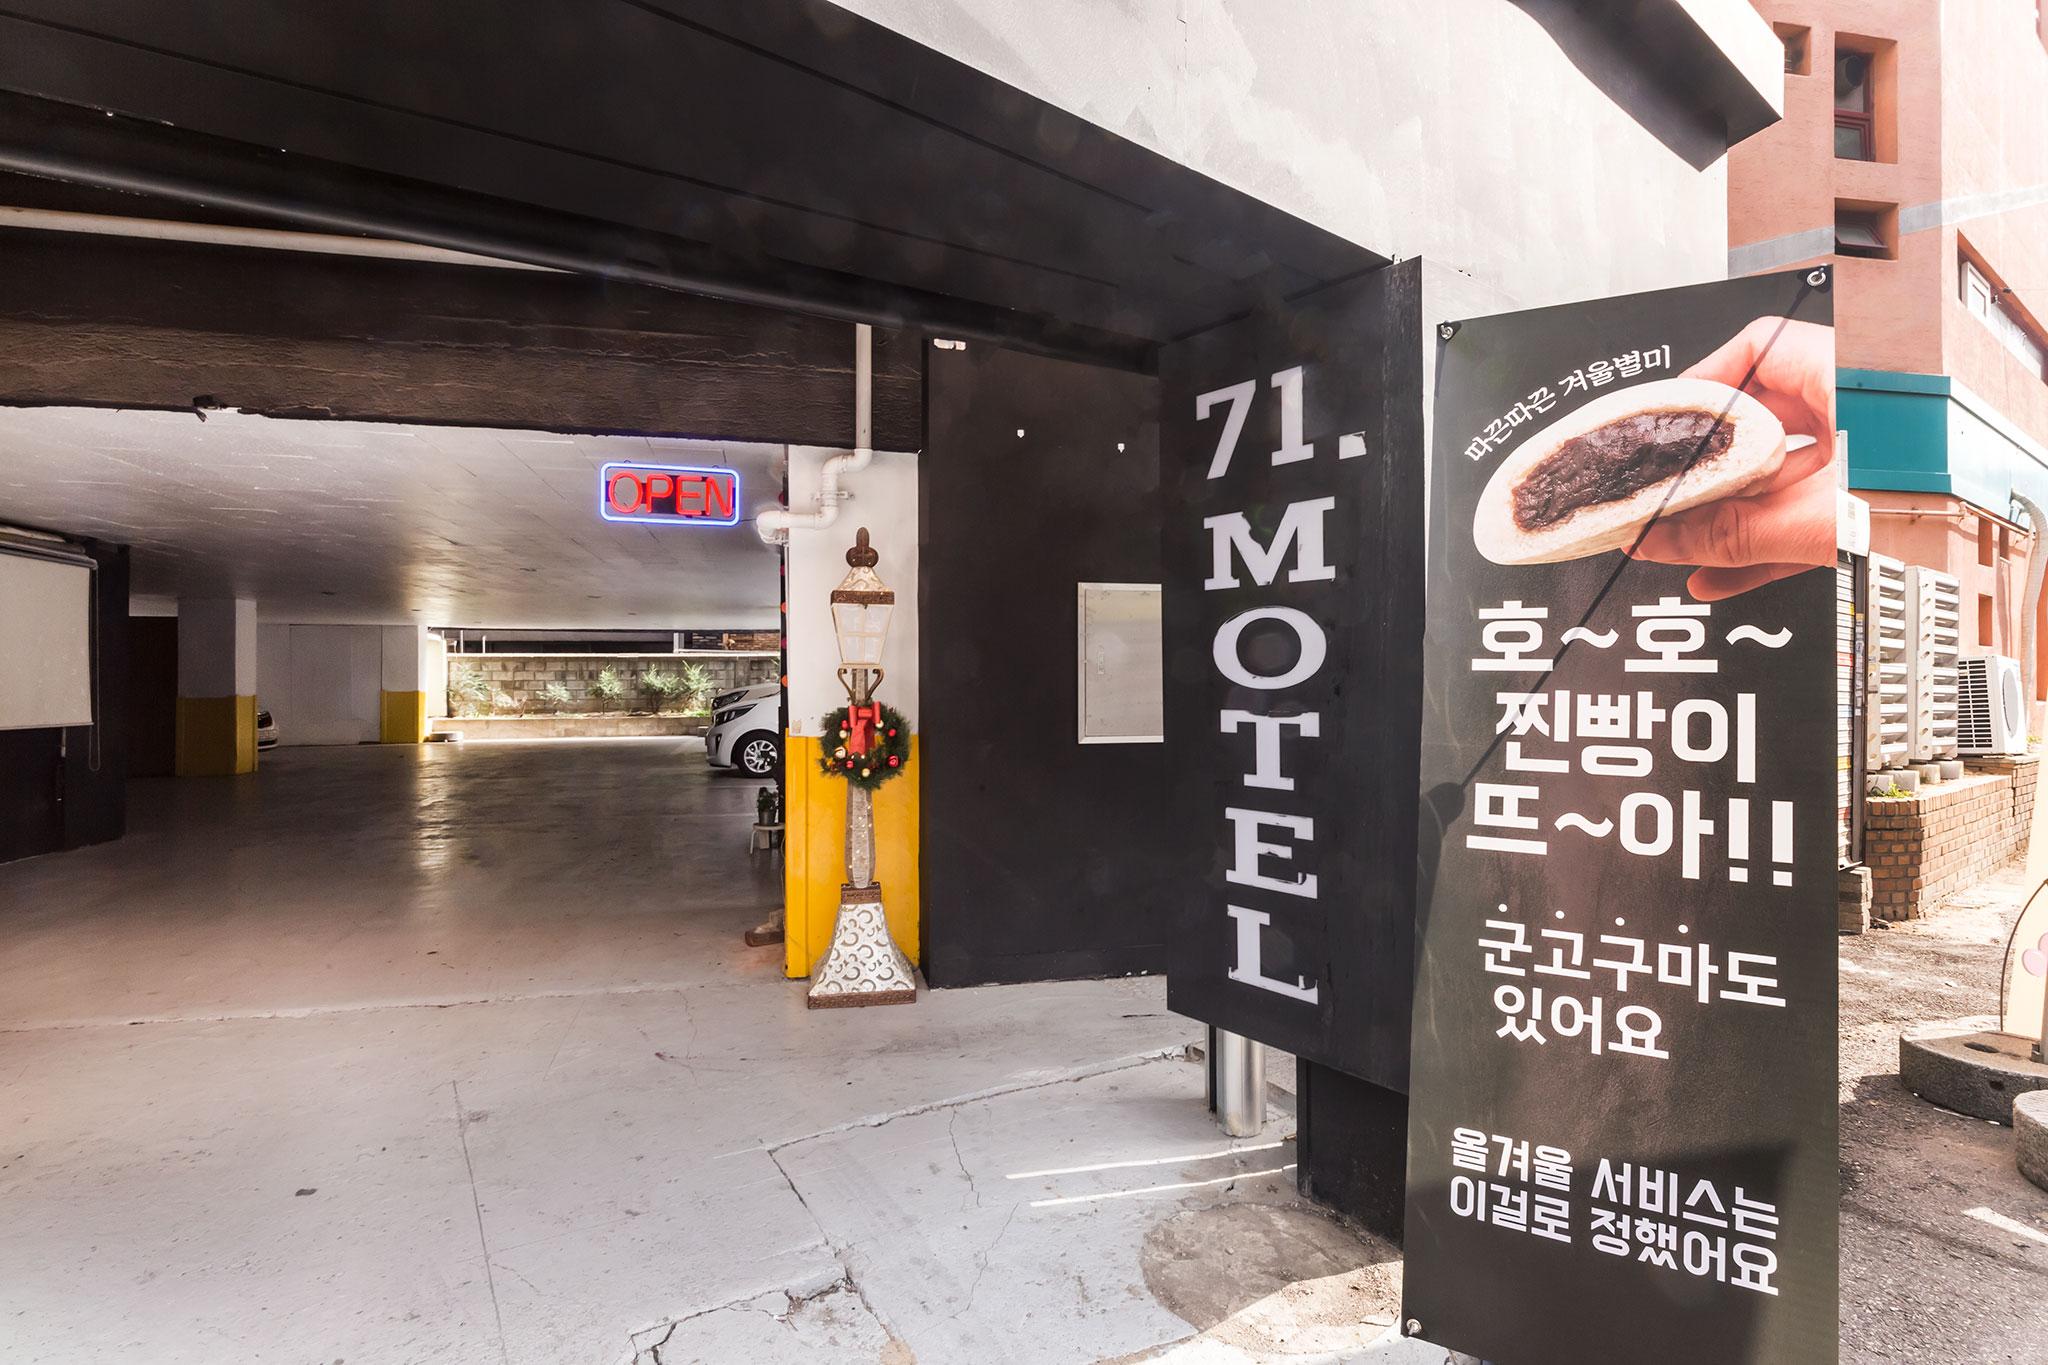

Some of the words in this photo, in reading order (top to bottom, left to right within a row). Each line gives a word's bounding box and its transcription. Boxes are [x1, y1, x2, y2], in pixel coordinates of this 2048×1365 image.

[1195, 366, 1367, 480] 71.
[1464, 386, 1557, 462] 따끈따끈
[1558, 345, 1671, 397] 겨울별미
[608, 471, 733, 518] OPEN
[1204, 496, 1336, 1006] MOTEL
[1493, 689, 1757, 785] 찐빵이
[1466, 782, 1794, 887] 뜨~아!!
[1478, 904, 1787, 1008] 군고구마도
[1493, 985, 1670, 1060] 있어요
[1450, 1127, 1574, 1192] 올겨울
[1591, 1157, 1780, 1240] 서비스는
[1450, 1175, 1572, 1244] 이걸로
[1591, 1206, 1780, 1297] 정했어요
